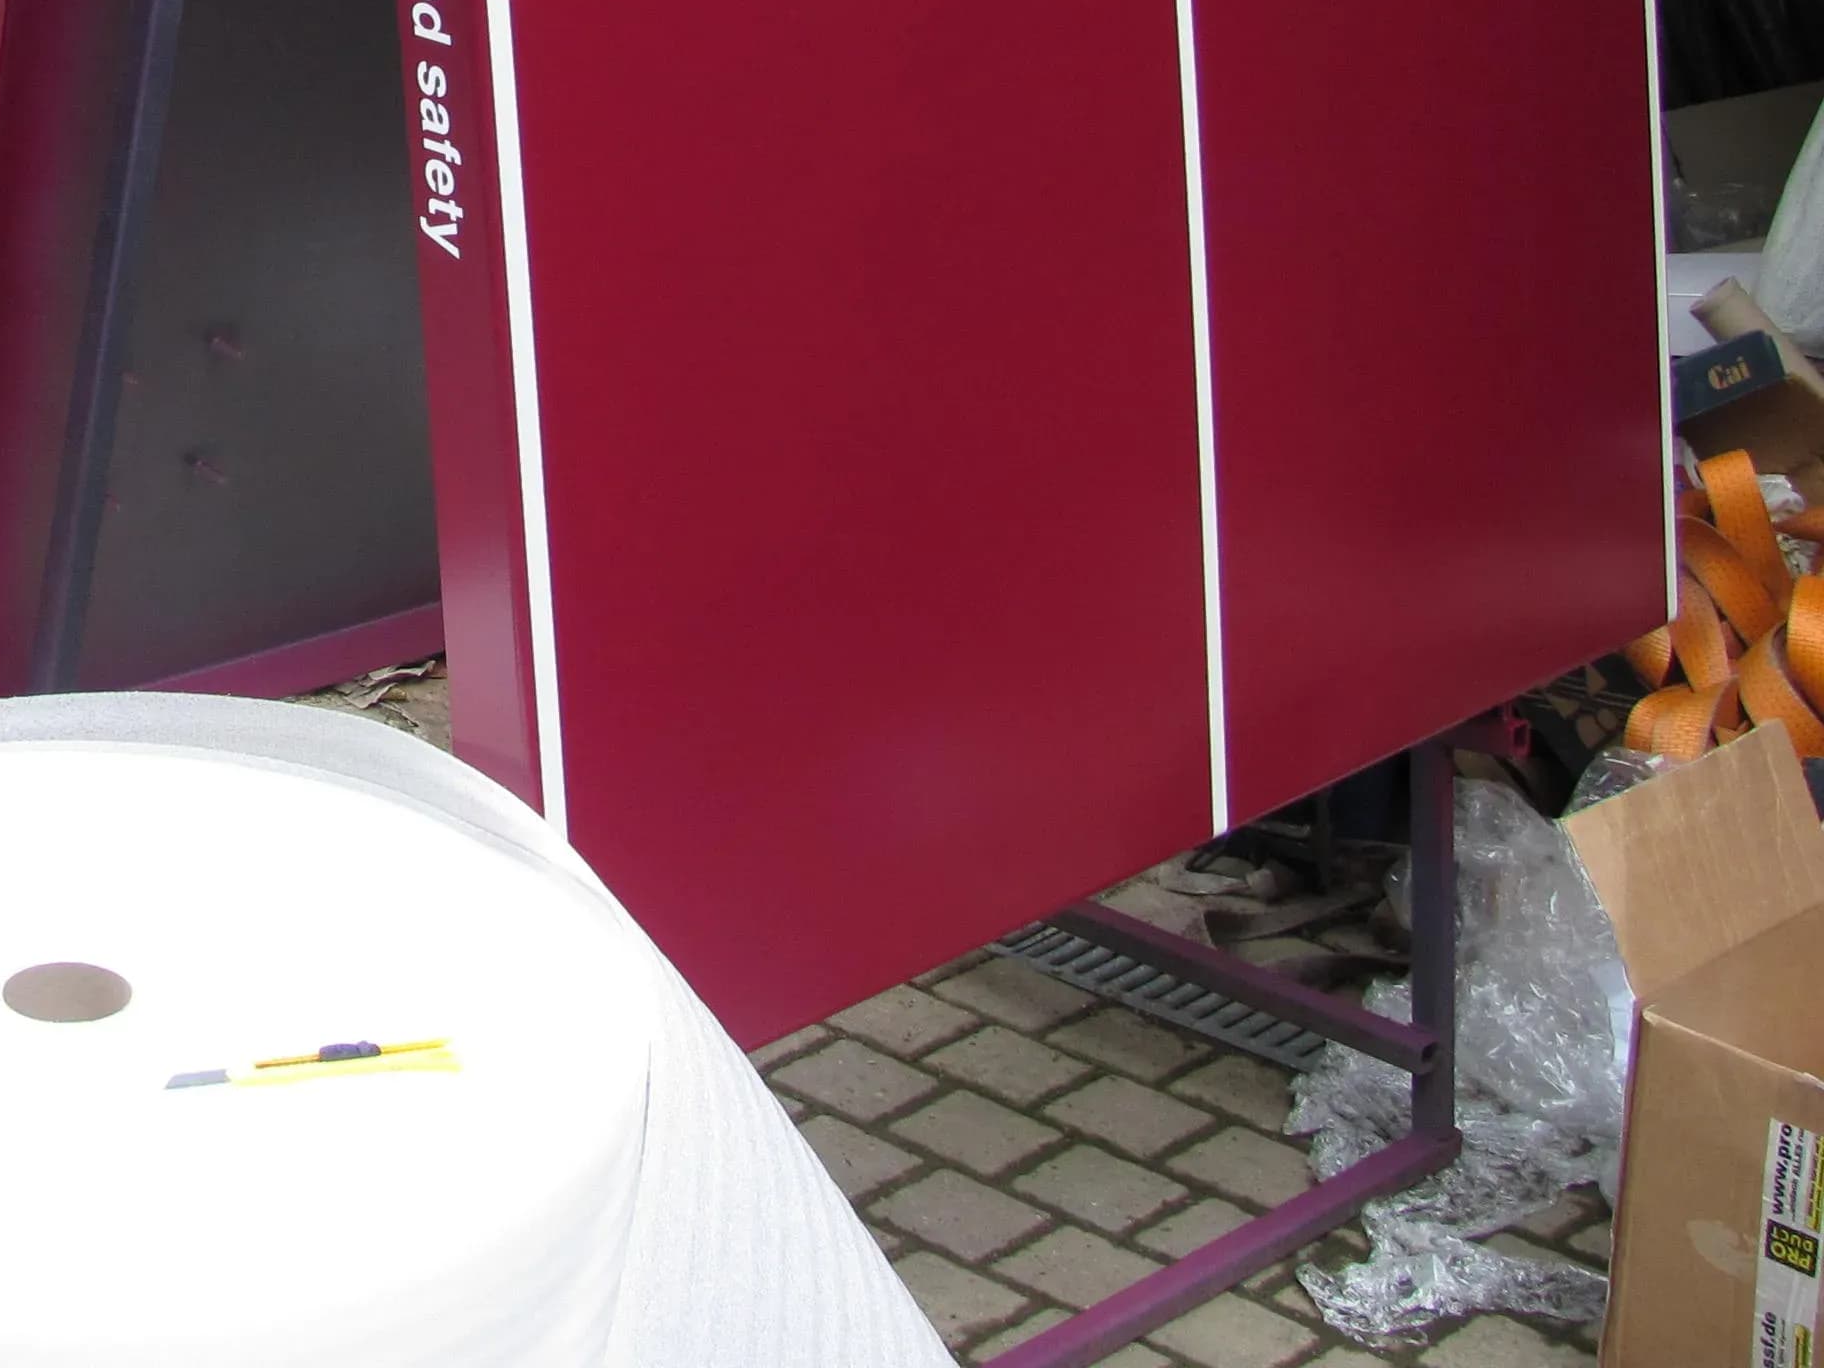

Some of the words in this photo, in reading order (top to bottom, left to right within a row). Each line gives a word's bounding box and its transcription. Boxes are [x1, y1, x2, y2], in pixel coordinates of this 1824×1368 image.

[417, 60, 464, 260] safety
[1770, 1226, 1814, 1252] DUCT
[1770, 1240, 1813, 1271] PRO
